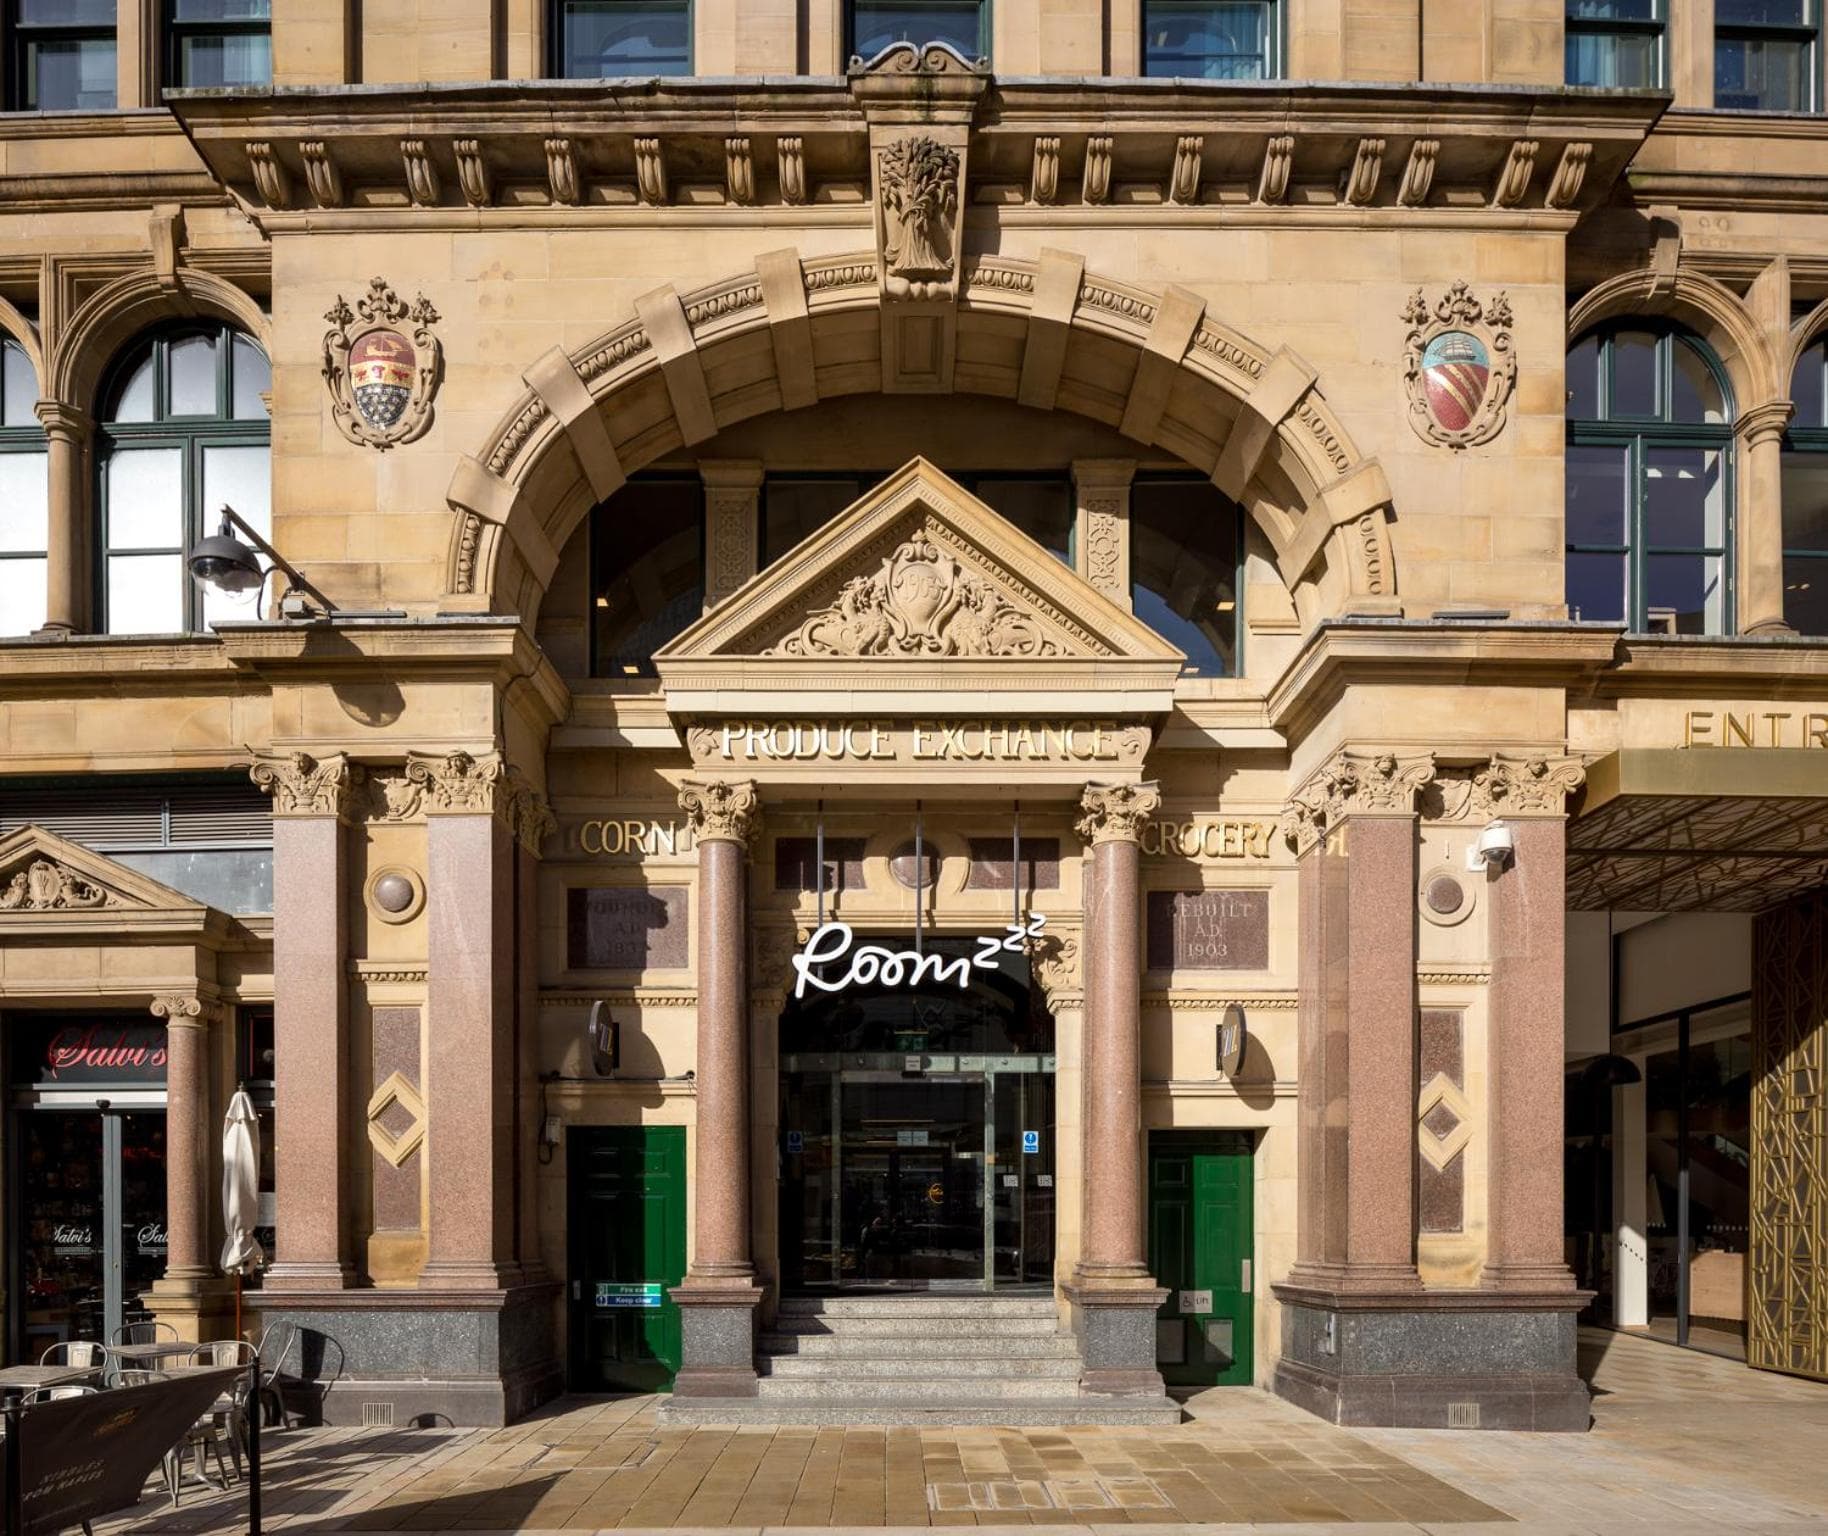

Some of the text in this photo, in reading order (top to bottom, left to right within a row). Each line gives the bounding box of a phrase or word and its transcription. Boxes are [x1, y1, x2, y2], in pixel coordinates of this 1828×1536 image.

[722, 720, 1119, 760] PRODUCE EXCHANGE
[580, 820, 677, 855] CORN
[1140, 821, 1277, 858] GROCERY
[1187, 943, 1228, 957] 1903
[49, 1026, 167, 1079] Salvi's
[615, 1296, 634, 1304] Keep
